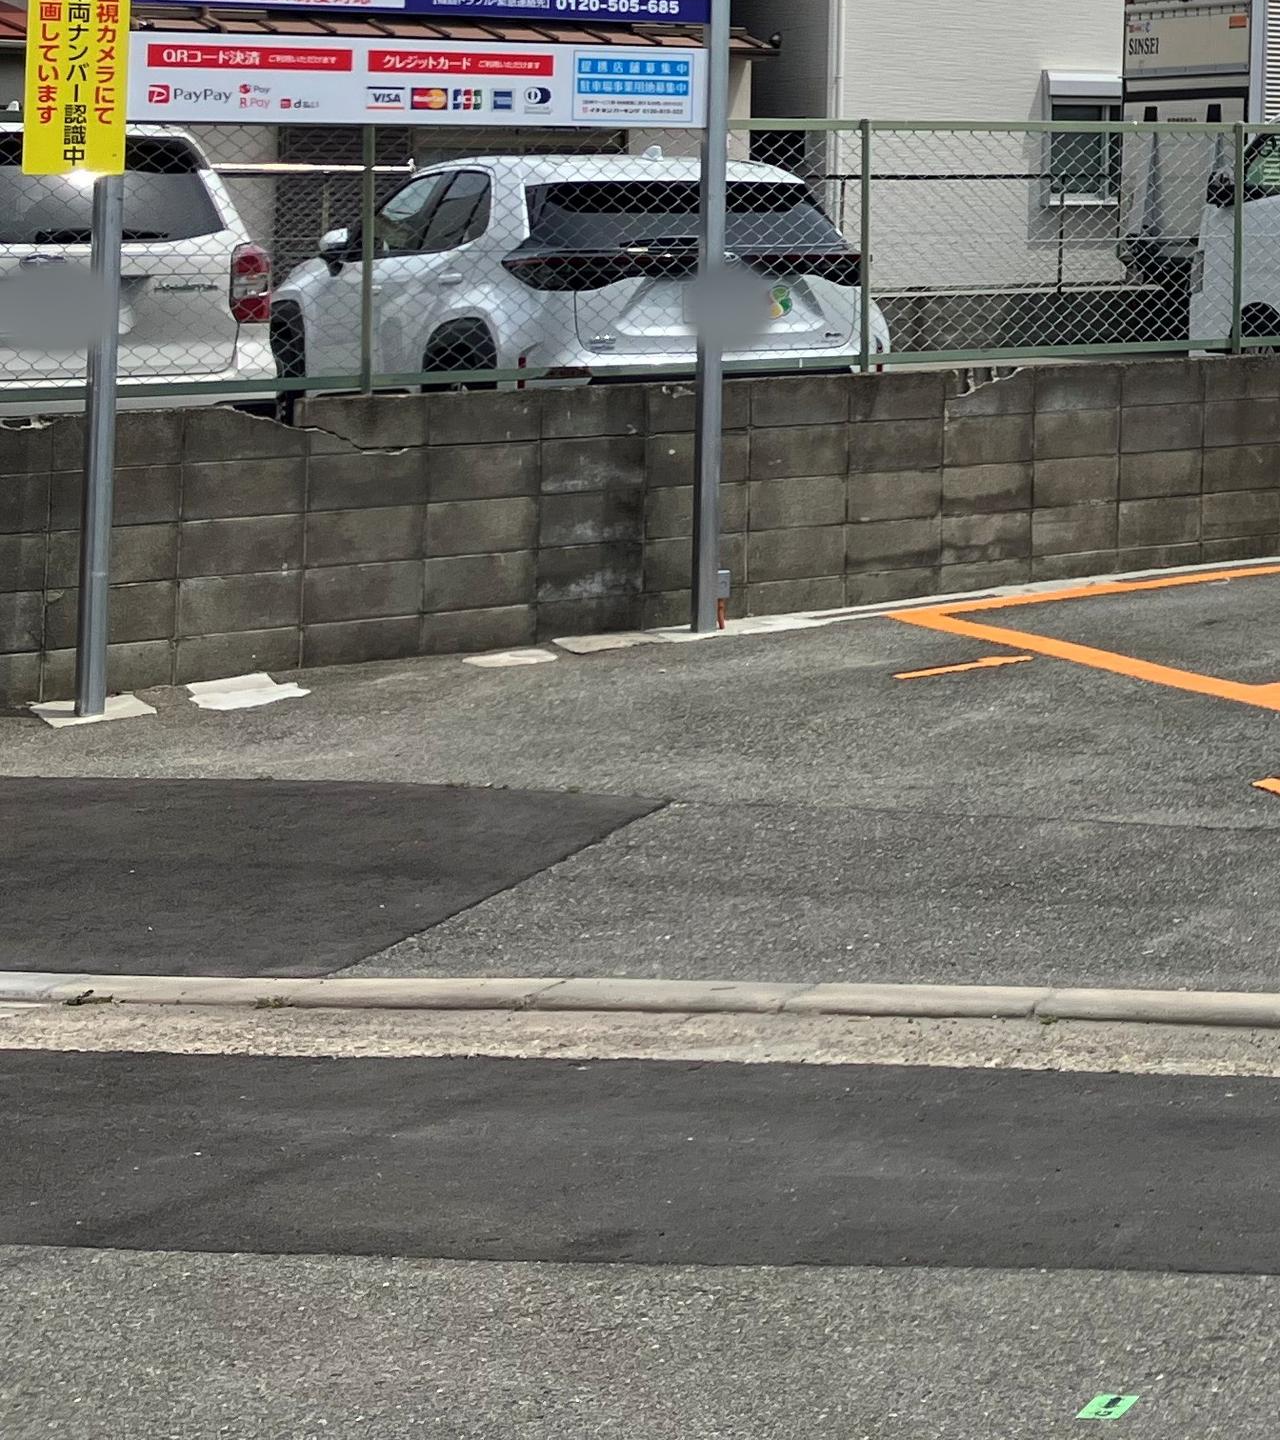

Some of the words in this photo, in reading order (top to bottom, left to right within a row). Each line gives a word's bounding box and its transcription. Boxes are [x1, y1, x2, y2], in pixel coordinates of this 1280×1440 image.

[1128, 36, 1160, 56] SINSEI
[162, 48, 261, 66] QRコード決済
[382, 54, 472, 71] クレジットカード
[173, 87, 233, 104] PayPay
